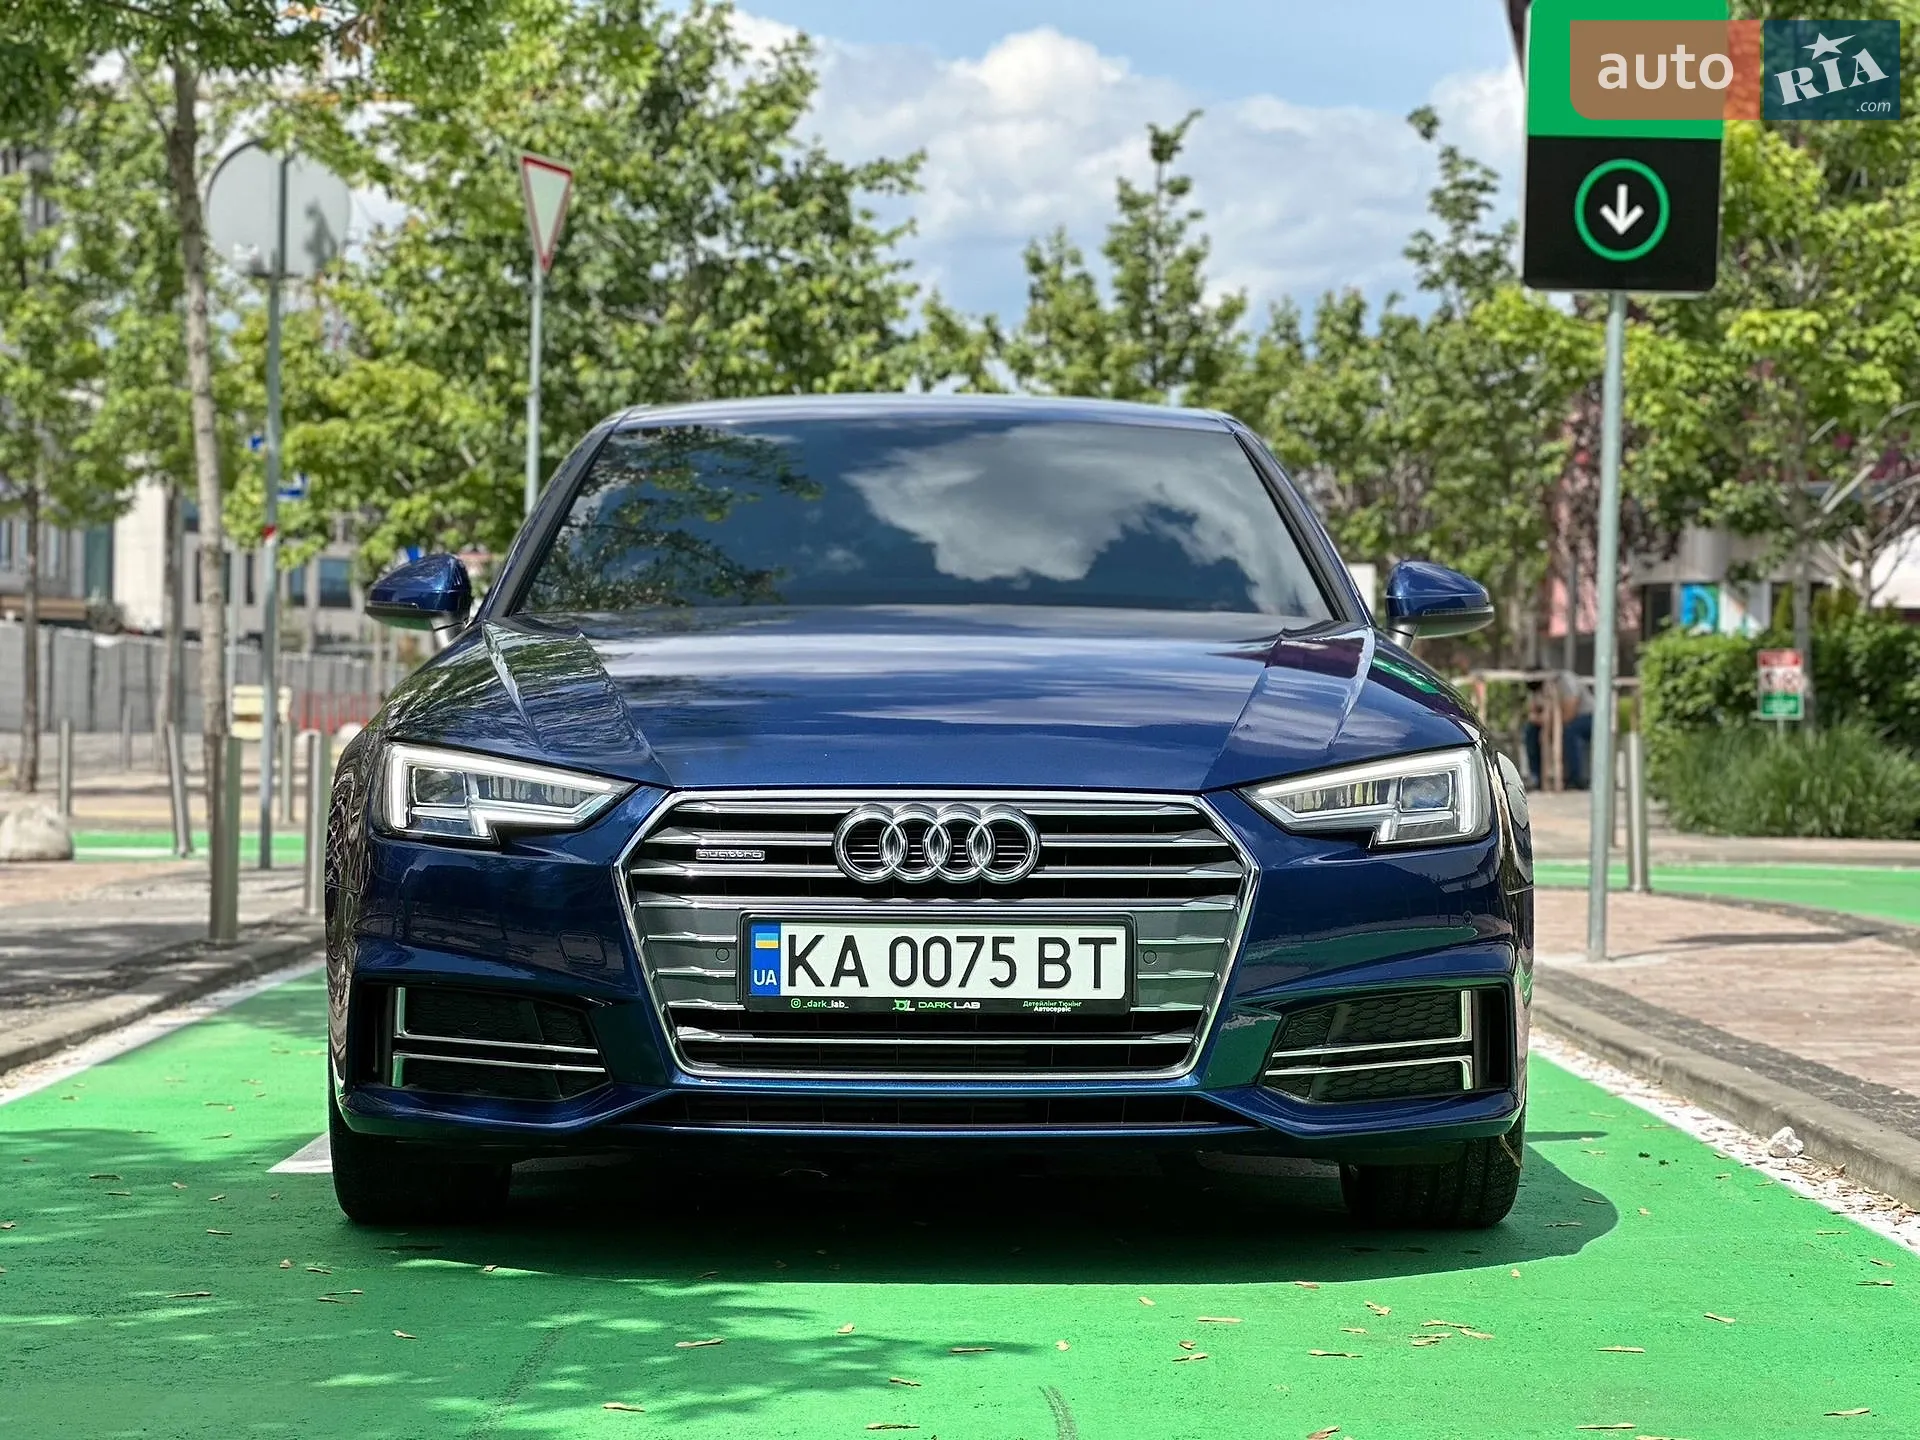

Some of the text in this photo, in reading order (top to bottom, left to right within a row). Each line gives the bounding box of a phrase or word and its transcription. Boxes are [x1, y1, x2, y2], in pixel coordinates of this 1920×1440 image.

[787, 934, 1117, 989] KA 0075 BT
[753, 970, 778, 986] UA
[802, 1000, 850, 1009] _dark_lab_
[918, 1001, 952, 1009] DARK
[953, 1001, 981, 1009] LAB
[1023, 1000, 1082, 1008] Детейлінг Тюнінг
[1033, 1005, 1072, 1013] Автосервіс
